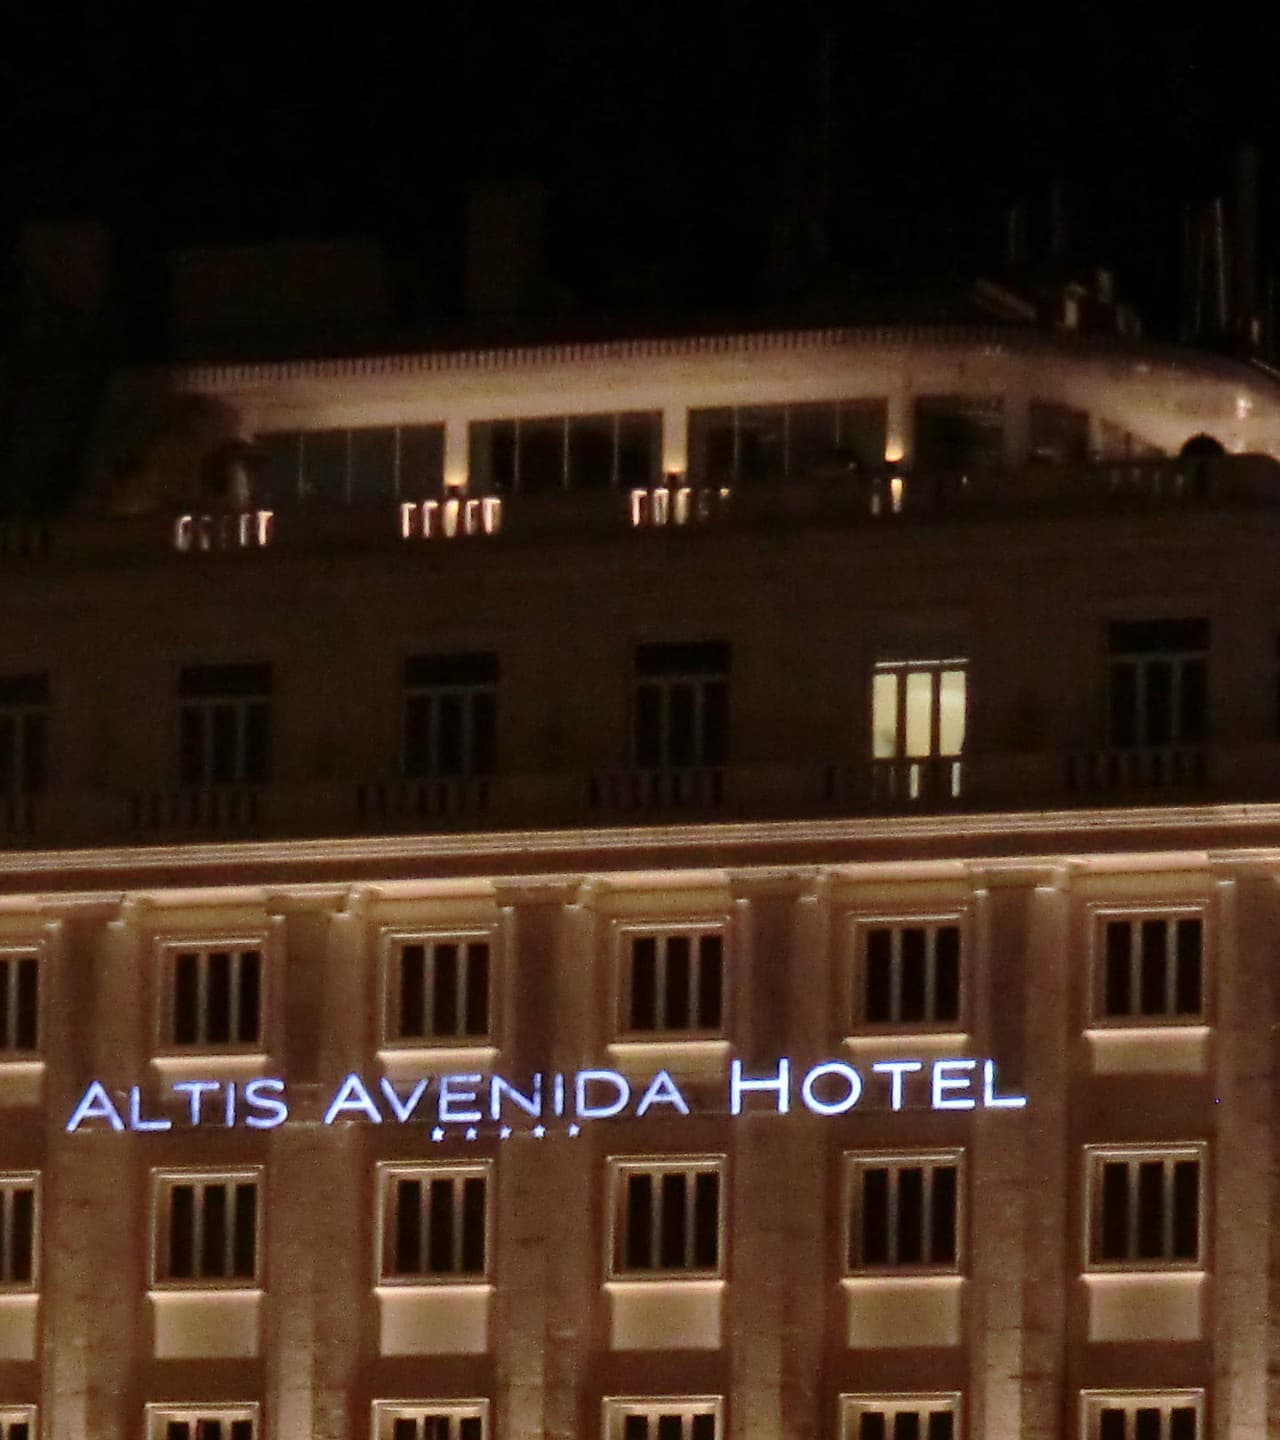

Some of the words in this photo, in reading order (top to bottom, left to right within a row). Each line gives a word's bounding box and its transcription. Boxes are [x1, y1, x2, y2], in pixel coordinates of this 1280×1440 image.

[66, 1077, 289, 1133] ALTIS
[324, 1070, 690, 1125] AVENIDA
[729, 1057, 1029, 1116] HOTEL
